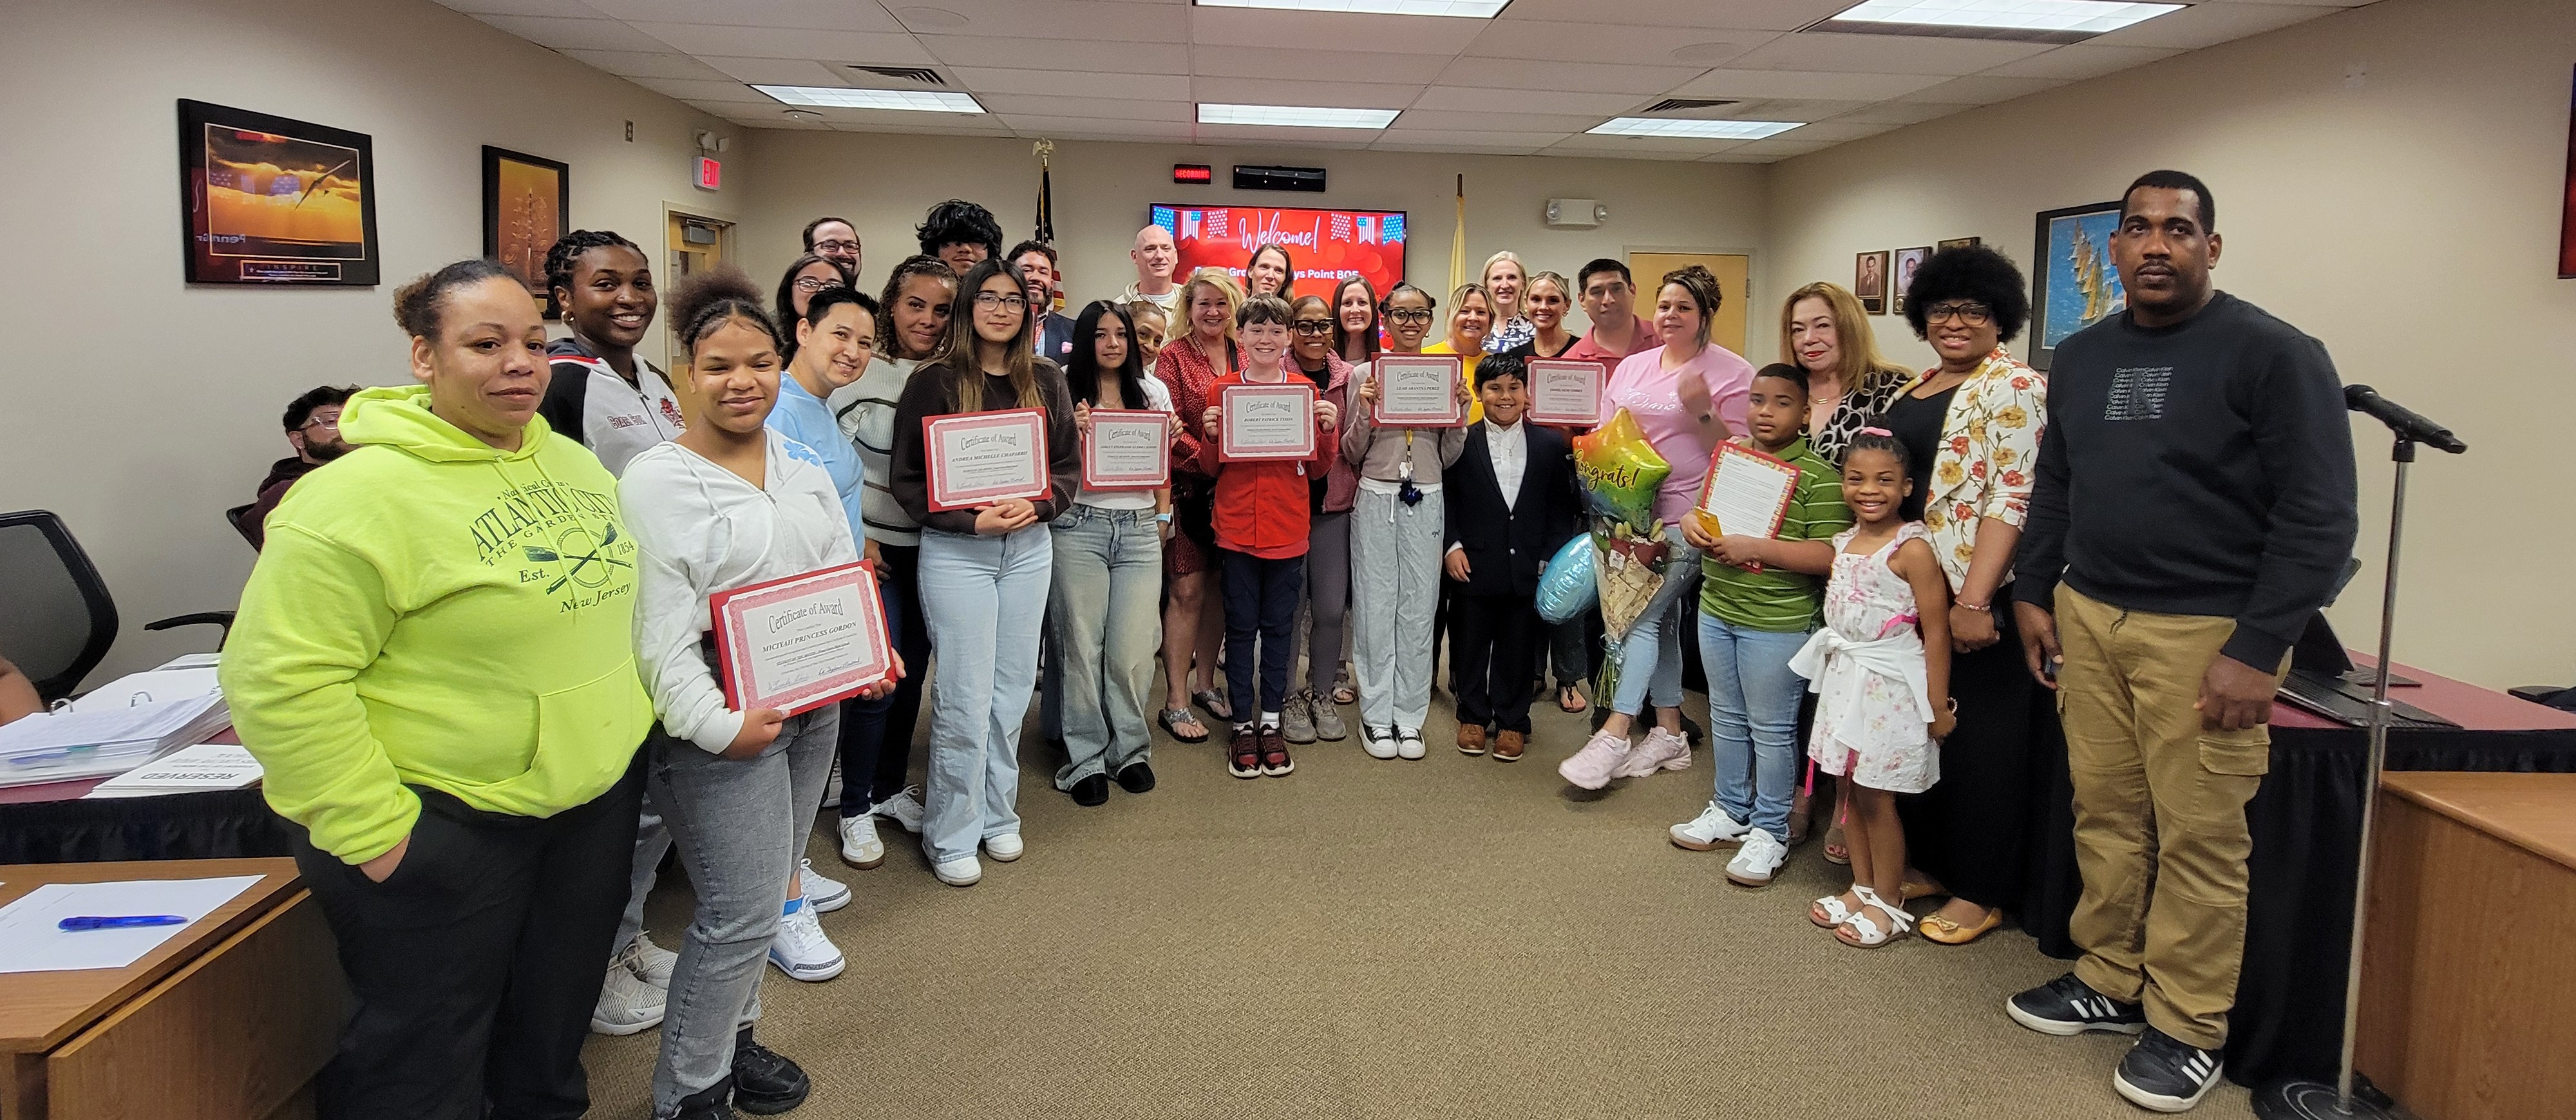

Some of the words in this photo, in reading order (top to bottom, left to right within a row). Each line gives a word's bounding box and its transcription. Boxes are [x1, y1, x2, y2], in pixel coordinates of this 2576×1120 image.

[703, 160, 720, 186] EXIT
[1238, 210, 1320, 254] Welcome!
[1229, 268, 1246, 277] Gro
[1307, 269, 1334, 279] Point
[1397, 371, 1419, 382] Certificate
[1426, 372, 1439, 382] Award
[1245, 401, 1269, 413] Certificate
[1276, 401, 1291, 413] Award
[961, 435, 990, 451] Certificate
[990, 434, 998, 442] of
[998, 433, 1017, 446] Award
[1108, 429, 1131, 441] Certificate
[1138, 429, 1151, 441] Award
[501, 480, 541, 500] Nauical
[541, 479, 565, 488] Crw
[469, 488, 580, 562] ATLANTIC
[486, 539, 517, 567] THE
[524, 514, 586, 538] GARDEN
[616, 540, 634, 556] 1854
[519, 567, 550, 584] Est.
[559, 596, 592, 613] New
[593, 582, 631, 607] Jersey
[769, 607, 807, 634] Certificate
[809, 603, 817, 615] of
[819, 598, 844, 616] Award
[762, 638, 793, 653] MICIYAH
[795, 629, 828, 644] PRINCESS
[829, 621, 857, 634] GORDON
